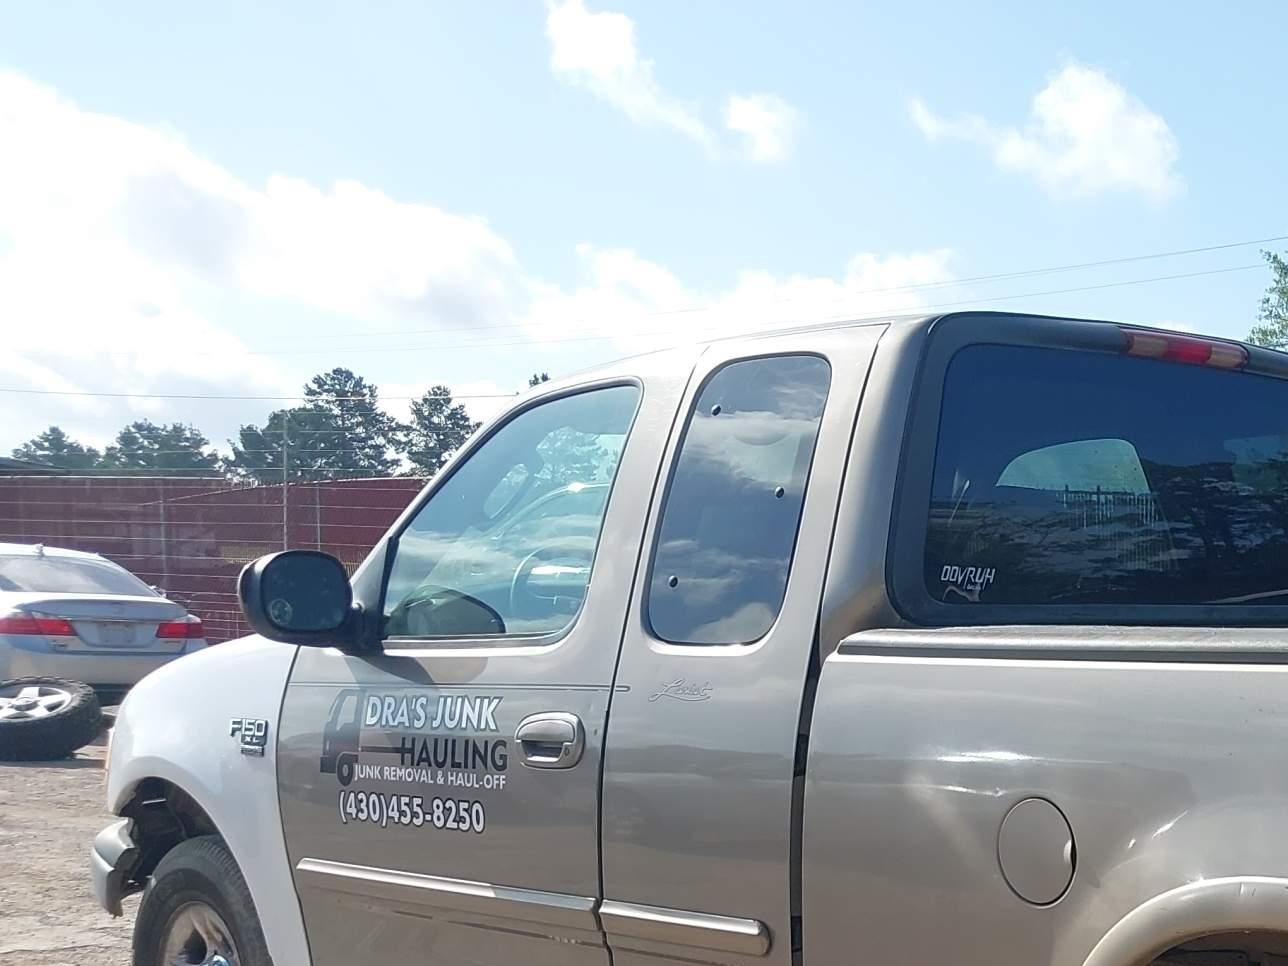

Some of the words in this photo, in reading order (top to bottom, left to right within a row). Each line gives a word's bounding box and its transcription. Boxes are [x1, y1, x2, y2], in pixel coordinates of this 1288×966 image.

[229, 718, 266, 737] F150
[365, 695, 427, 729] DRA'S
[432, 695, 503, 732] JUNK
[401, 736, 508, 772] HAULING
[354, 763, 382, 781] JUNK
[383, 766, 434, 784] REMOVAL
[436, 770, 445, 785] &
[447, 771, 507, 790] HAUL-OFF
[339, 791, 486, 834] (430)455-8250
